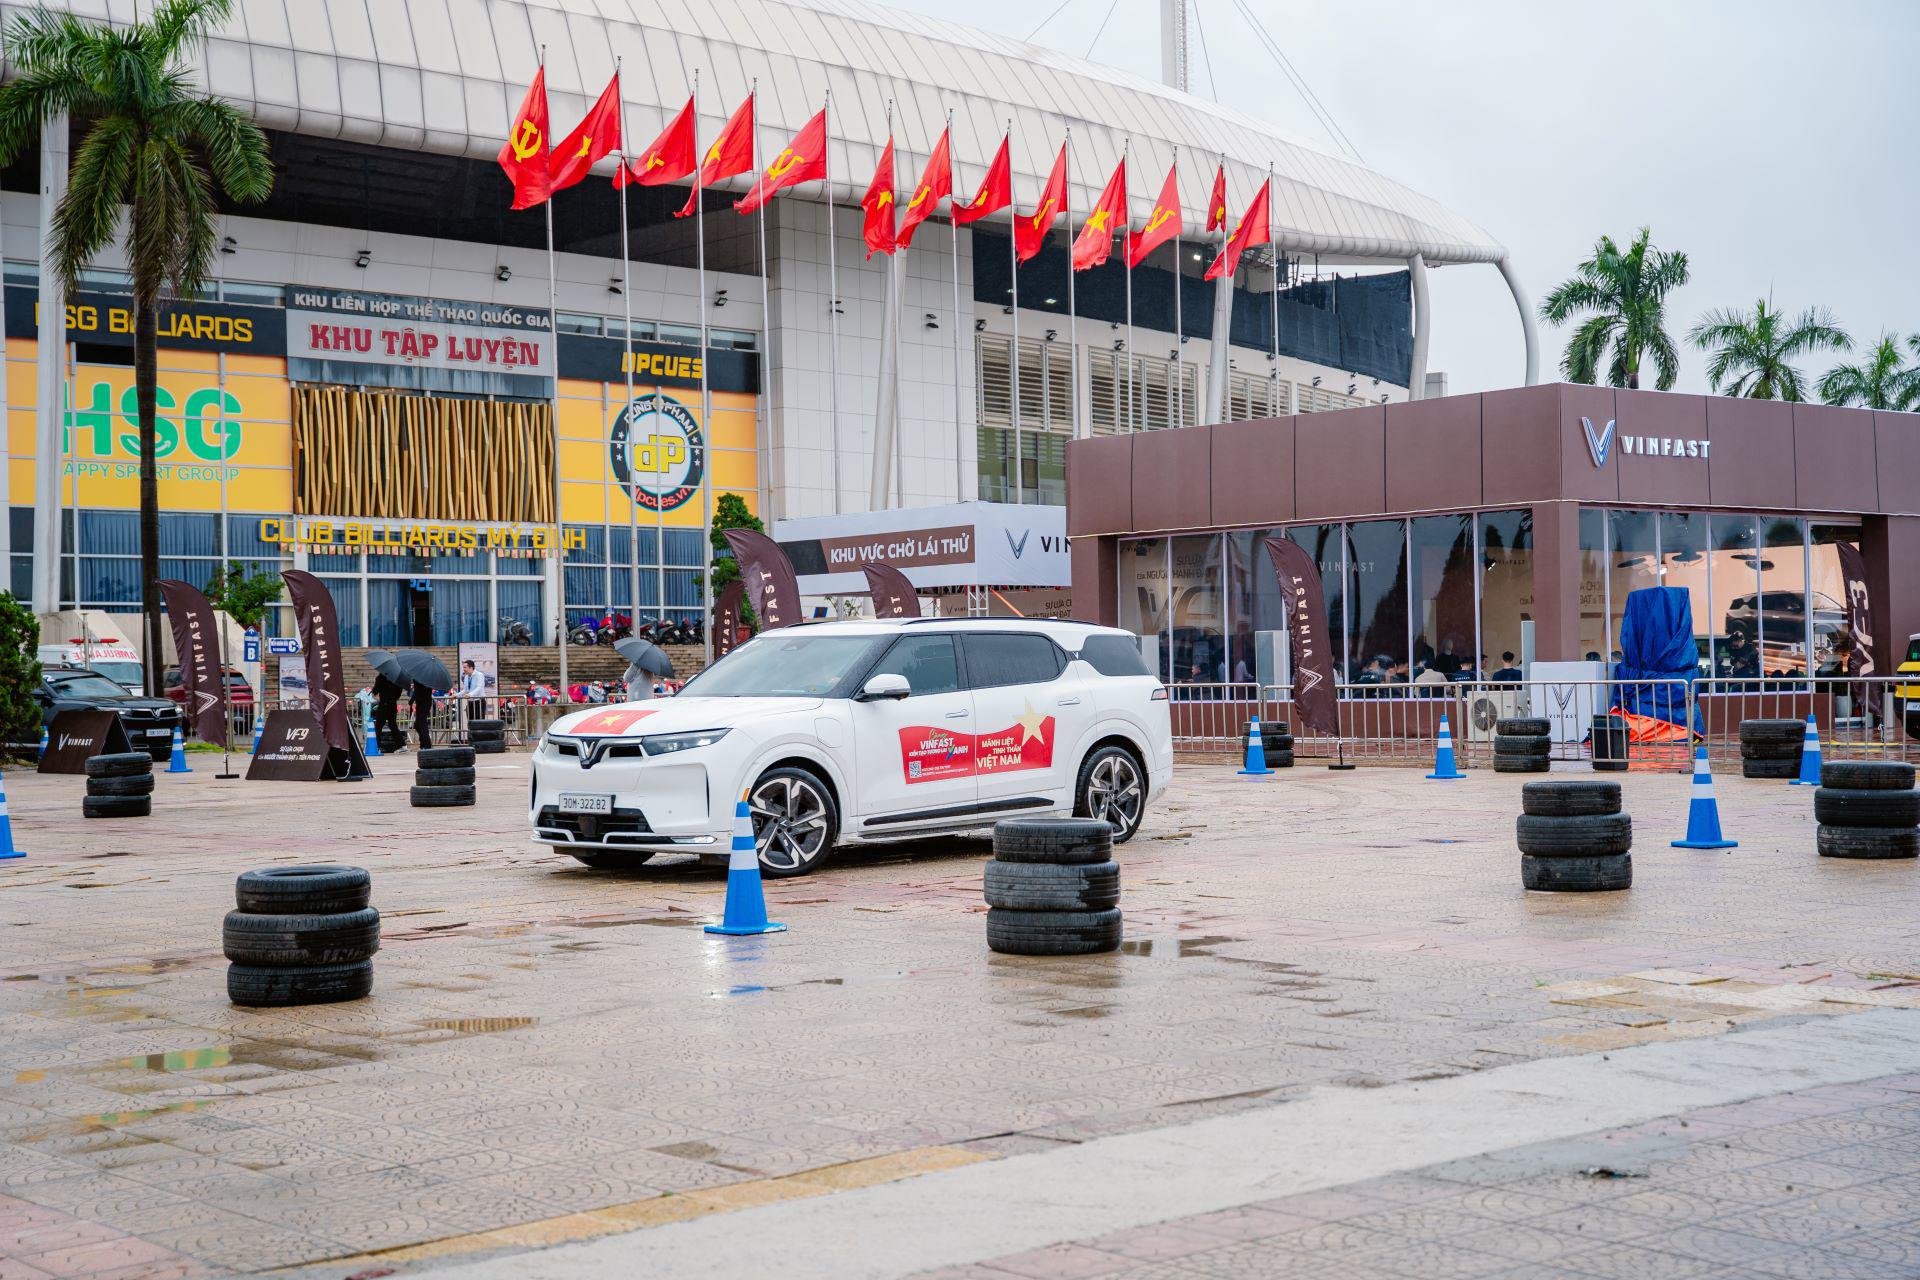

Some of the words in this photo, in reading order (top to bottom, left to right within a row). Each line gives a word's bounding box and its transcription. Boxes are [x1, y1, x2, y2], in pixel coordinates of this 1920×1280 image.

[295, 293, 327, 308] KHU
[332, 294, 365, 311] LIÊN
[370, 299, 400, 319] HỢP
[438, 306, 477, 321] THAO
[481, 307, 522, 326] QUỐC
[526, 314, 550, 328] GIA
[109, 308, 253, 342] BILIARDS
[310, 324, 372, 352] KHU
[381, 327, 439, 361] TẬP
[448, 335, 540, 369] LUYỆN
[1620, 435, 1710, 458] VINFAST
[64, 462, 110, 477] APPY
[115, 464, 172, 480] SPRT
[177, 466, 240, 482] GROUP
[260, 519, 333, 543] CLUB
[345, 522, 477, 548] BILLIARDS
[831, 546, 856, 563] KHU
[859, 542, 885, 563] VỰC
[887, 538, 915, 558] CHỜ
[918, 536, 938, 556] LÁI
[941, 532, 970, 554] THỬ
[760, 572, 780, 622] FAST
[1293, 576, 1313, 658] VINFAST
[186, 611, 208, 683] VINFAST
[247, 647, 256, 660] B
[310, 604, 331, 680] VINFAST
[68, 738, 93, 746] VINFAST
[286, 728, 309, 740] VF9
[920, 737, 954, 750] VINFAST
[981, 738, 1000, 748] MÃNH
[976, 755, 998, 770] VIỆT
[1000, 754, 1021, 765] NAM
[992, 747, 1005, 755] TINH
